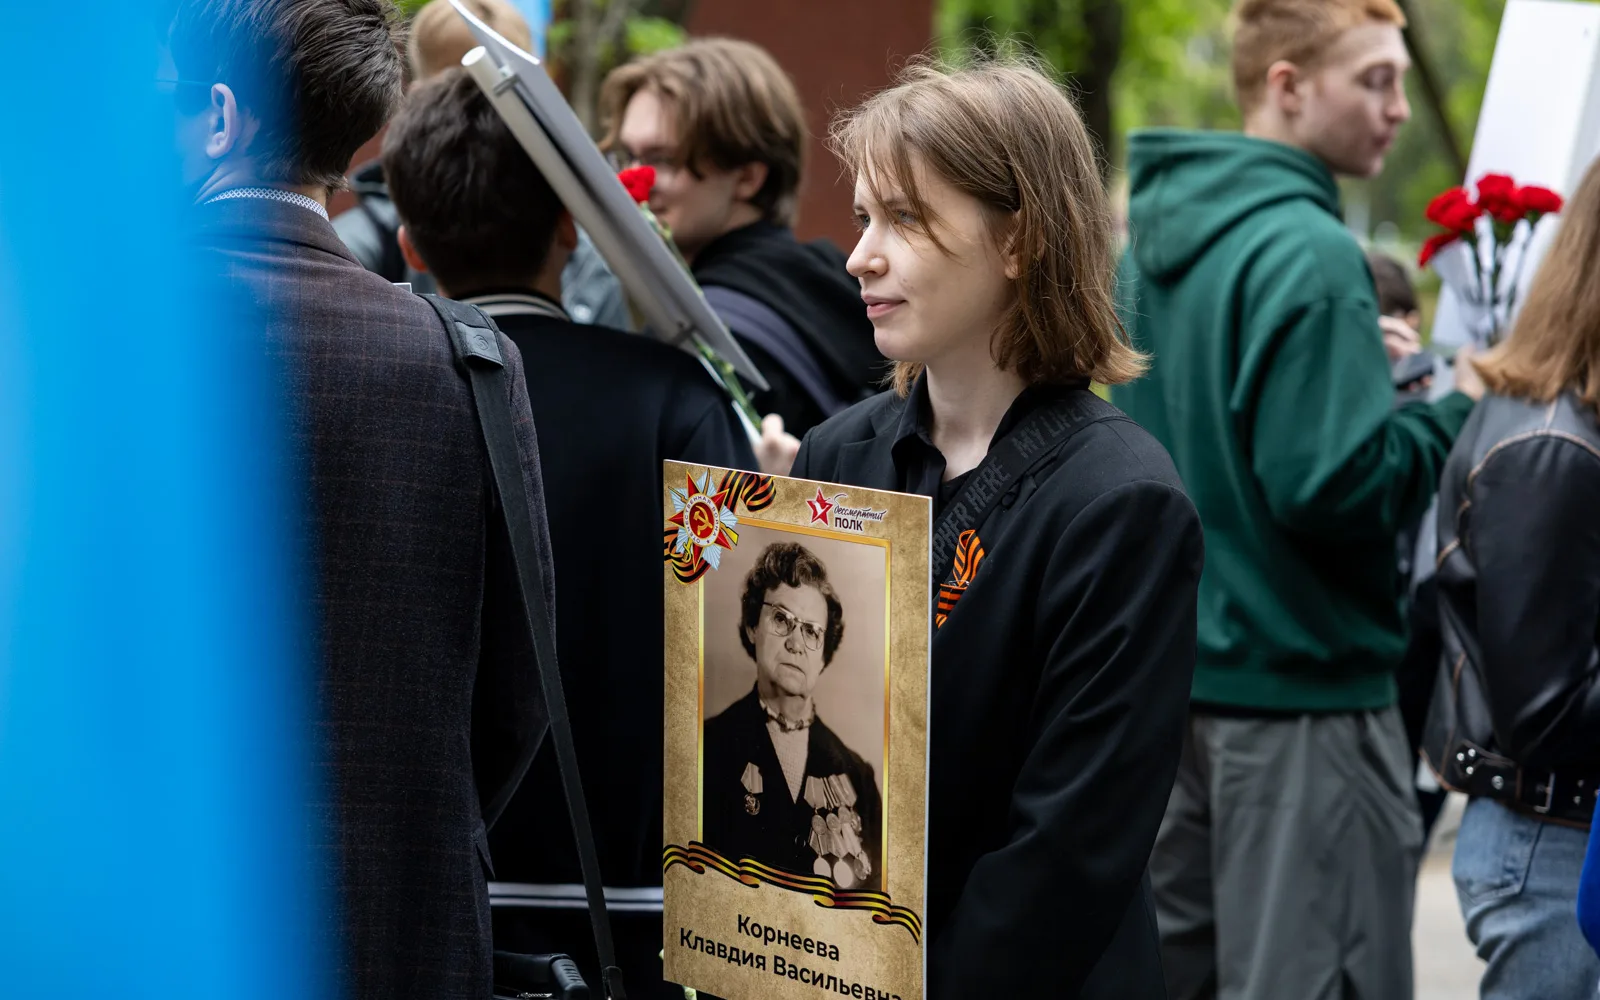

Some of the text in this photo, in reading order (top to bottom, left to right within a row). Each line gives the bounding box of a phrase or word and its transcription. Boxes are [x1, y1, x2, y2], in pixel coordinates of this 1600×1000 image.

[1011, 420, 1046, 460] MY
[834, 517, 864, 532] ПОЛК
[932, 456, 1012, 577] APHER HERE
[680, 927, 766, 971] Клавдия
[737, 914, 840, 962] Корнеева
